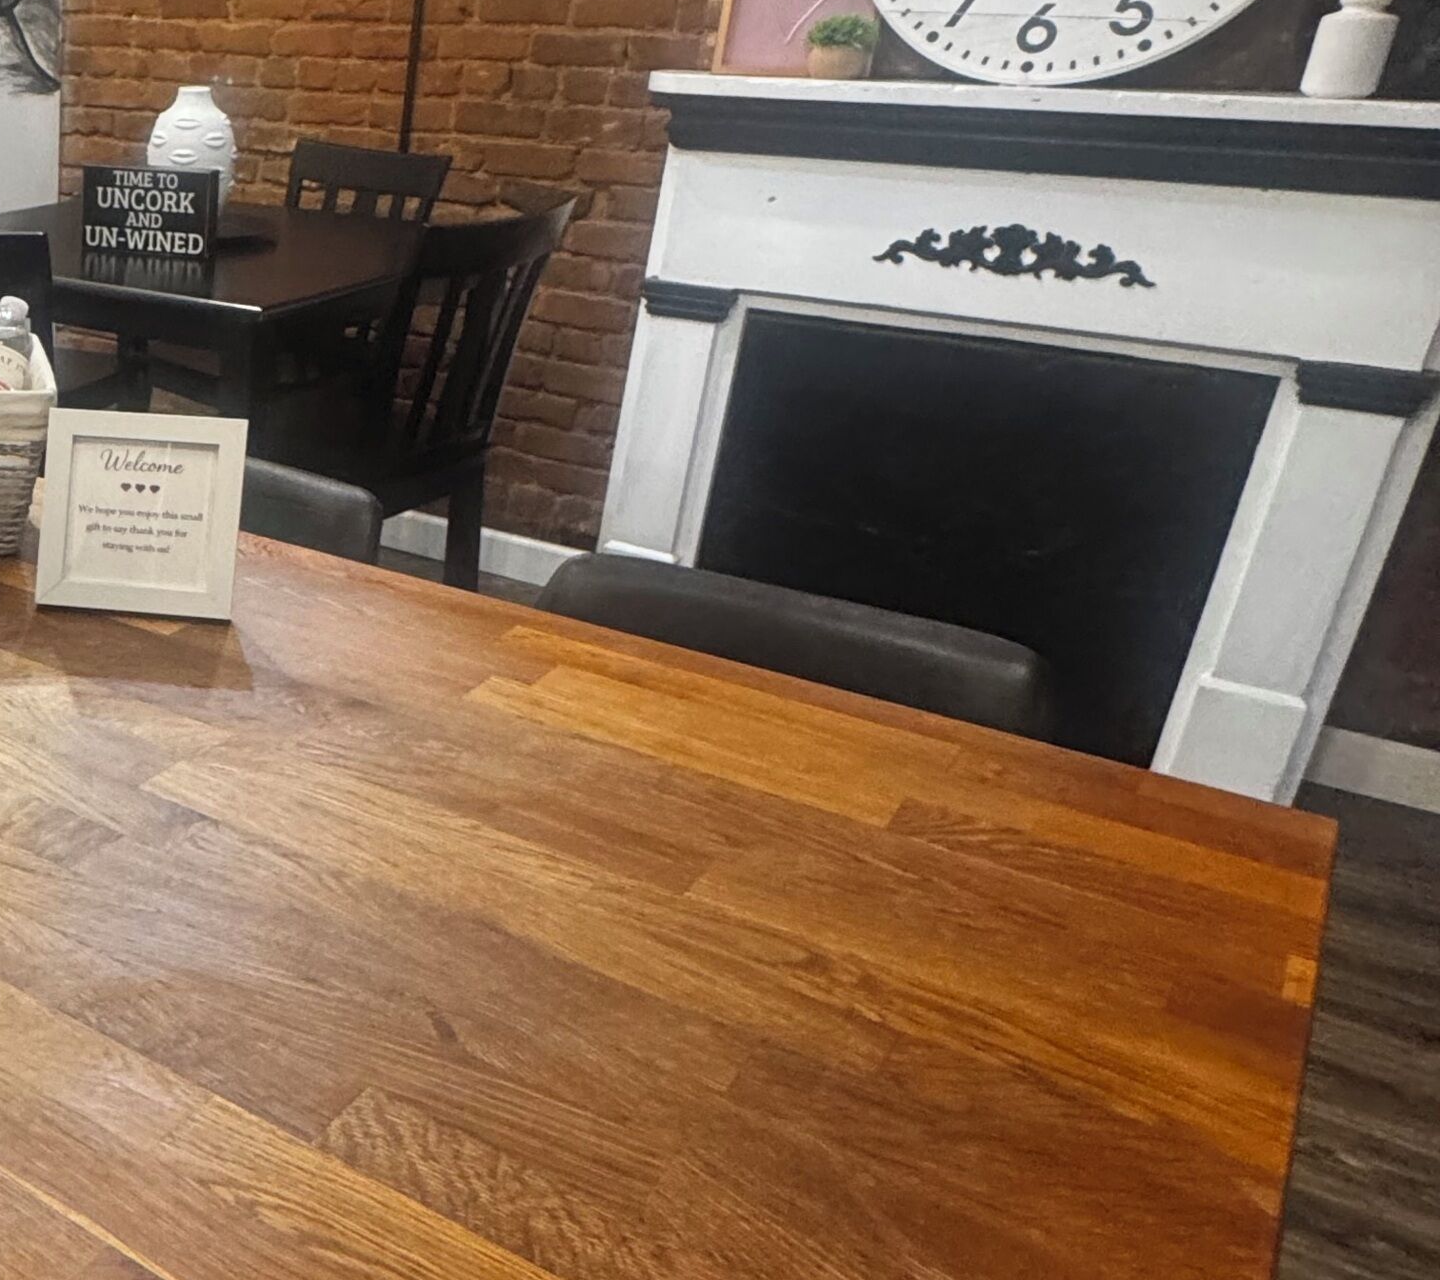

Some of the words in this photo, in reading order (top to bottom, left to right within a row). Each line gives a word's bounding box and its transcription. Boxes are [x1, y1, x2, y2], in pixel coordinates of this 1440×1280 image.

[1016, 4, 1058, 54] 6
[113, 170, 154, 187] TIME
[157, 173, 178, 189] TO
[96, 186, 196, 214] UNCORK
[125, 211, 163, 228] AND
[84, 225, 205, 255] UN-WINED
[100, 448, 185, 474] Welcome
[78, 504, 94, 513] We
[95, 506, 117, 517] hope
[118, 509, 135, 518] you
[136, 510, 159, 521] enjoy
[162, 511, 178, 520] this
[180, 513, 203, 521] small
[86, 523, 100, 533] gift
[113, 526, 128, 535] say
[129, 525, 154, 535] thank
[156, 529, 173, 537] you
[175, 529, 188, 537] for
[102, 542, 134, 553] staying
[135, 544, 155, 552] with
